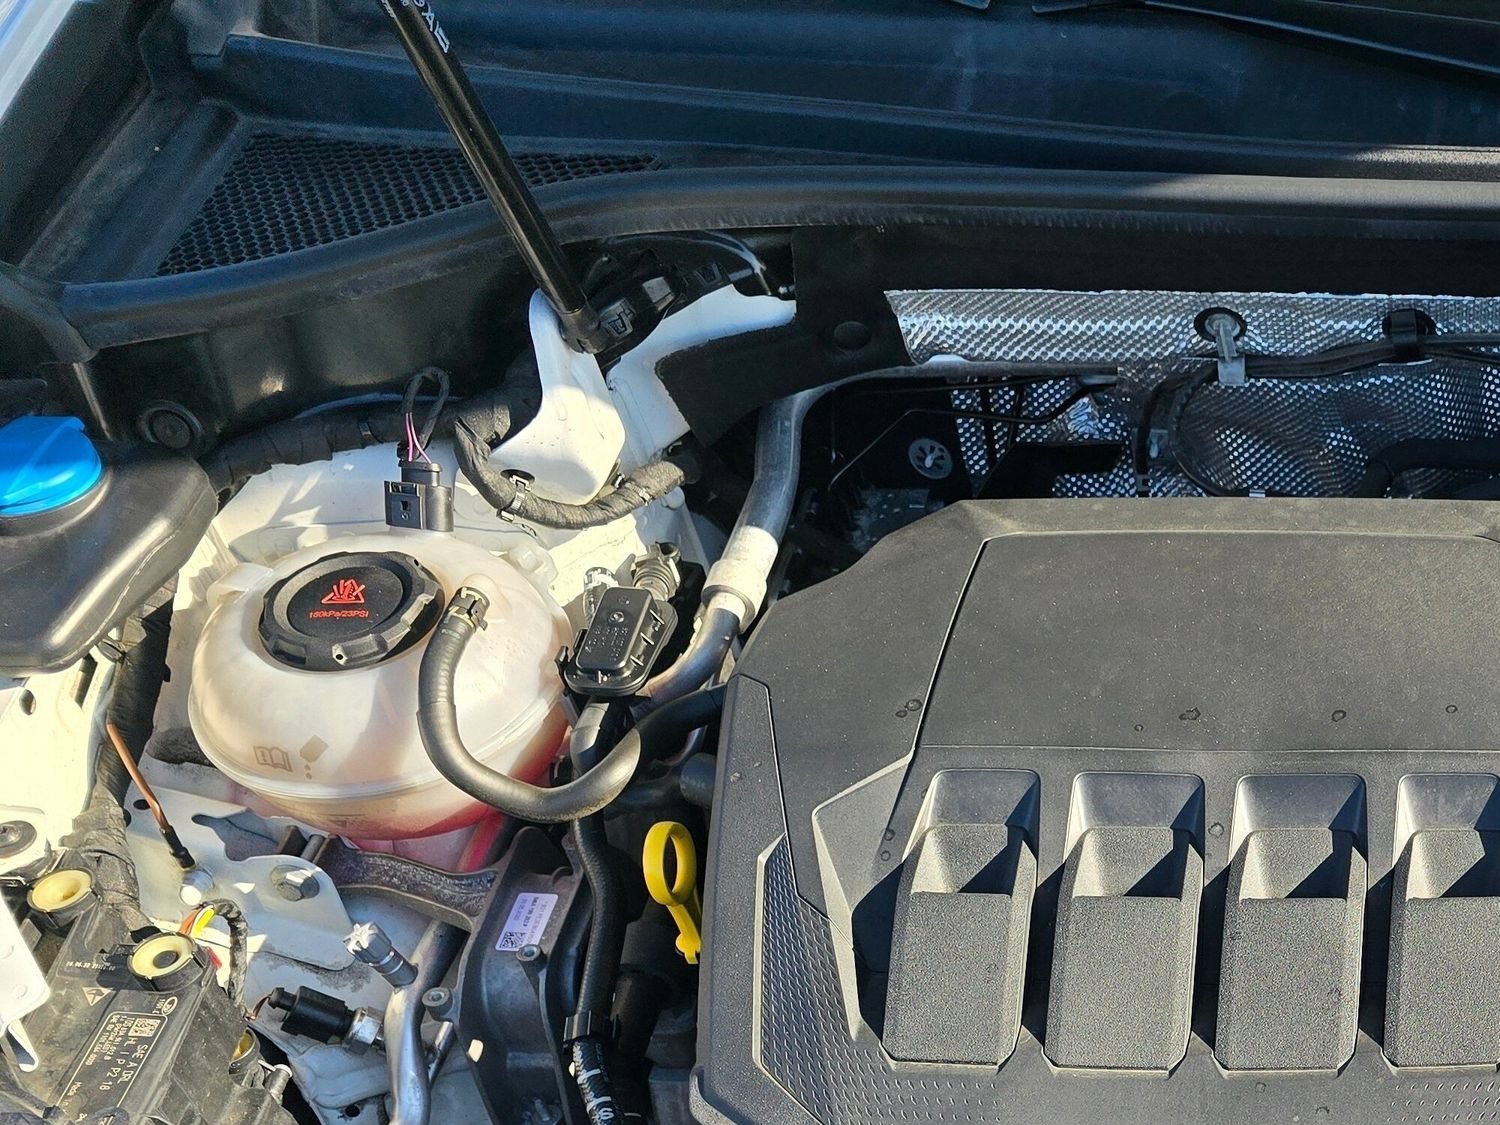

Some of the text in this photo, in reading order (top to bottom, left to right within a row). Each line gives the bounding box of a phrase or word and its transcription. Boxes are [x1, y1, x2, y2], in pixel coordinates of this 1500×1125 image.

[124, 1037, 138, 1047] HL
[132, 1045, 148, 1059] SAE
[106, 1067, 121, 1077] P2
[117, 1071, 134, 1084] DRL
[100, 1081, 112, 1090] 18
